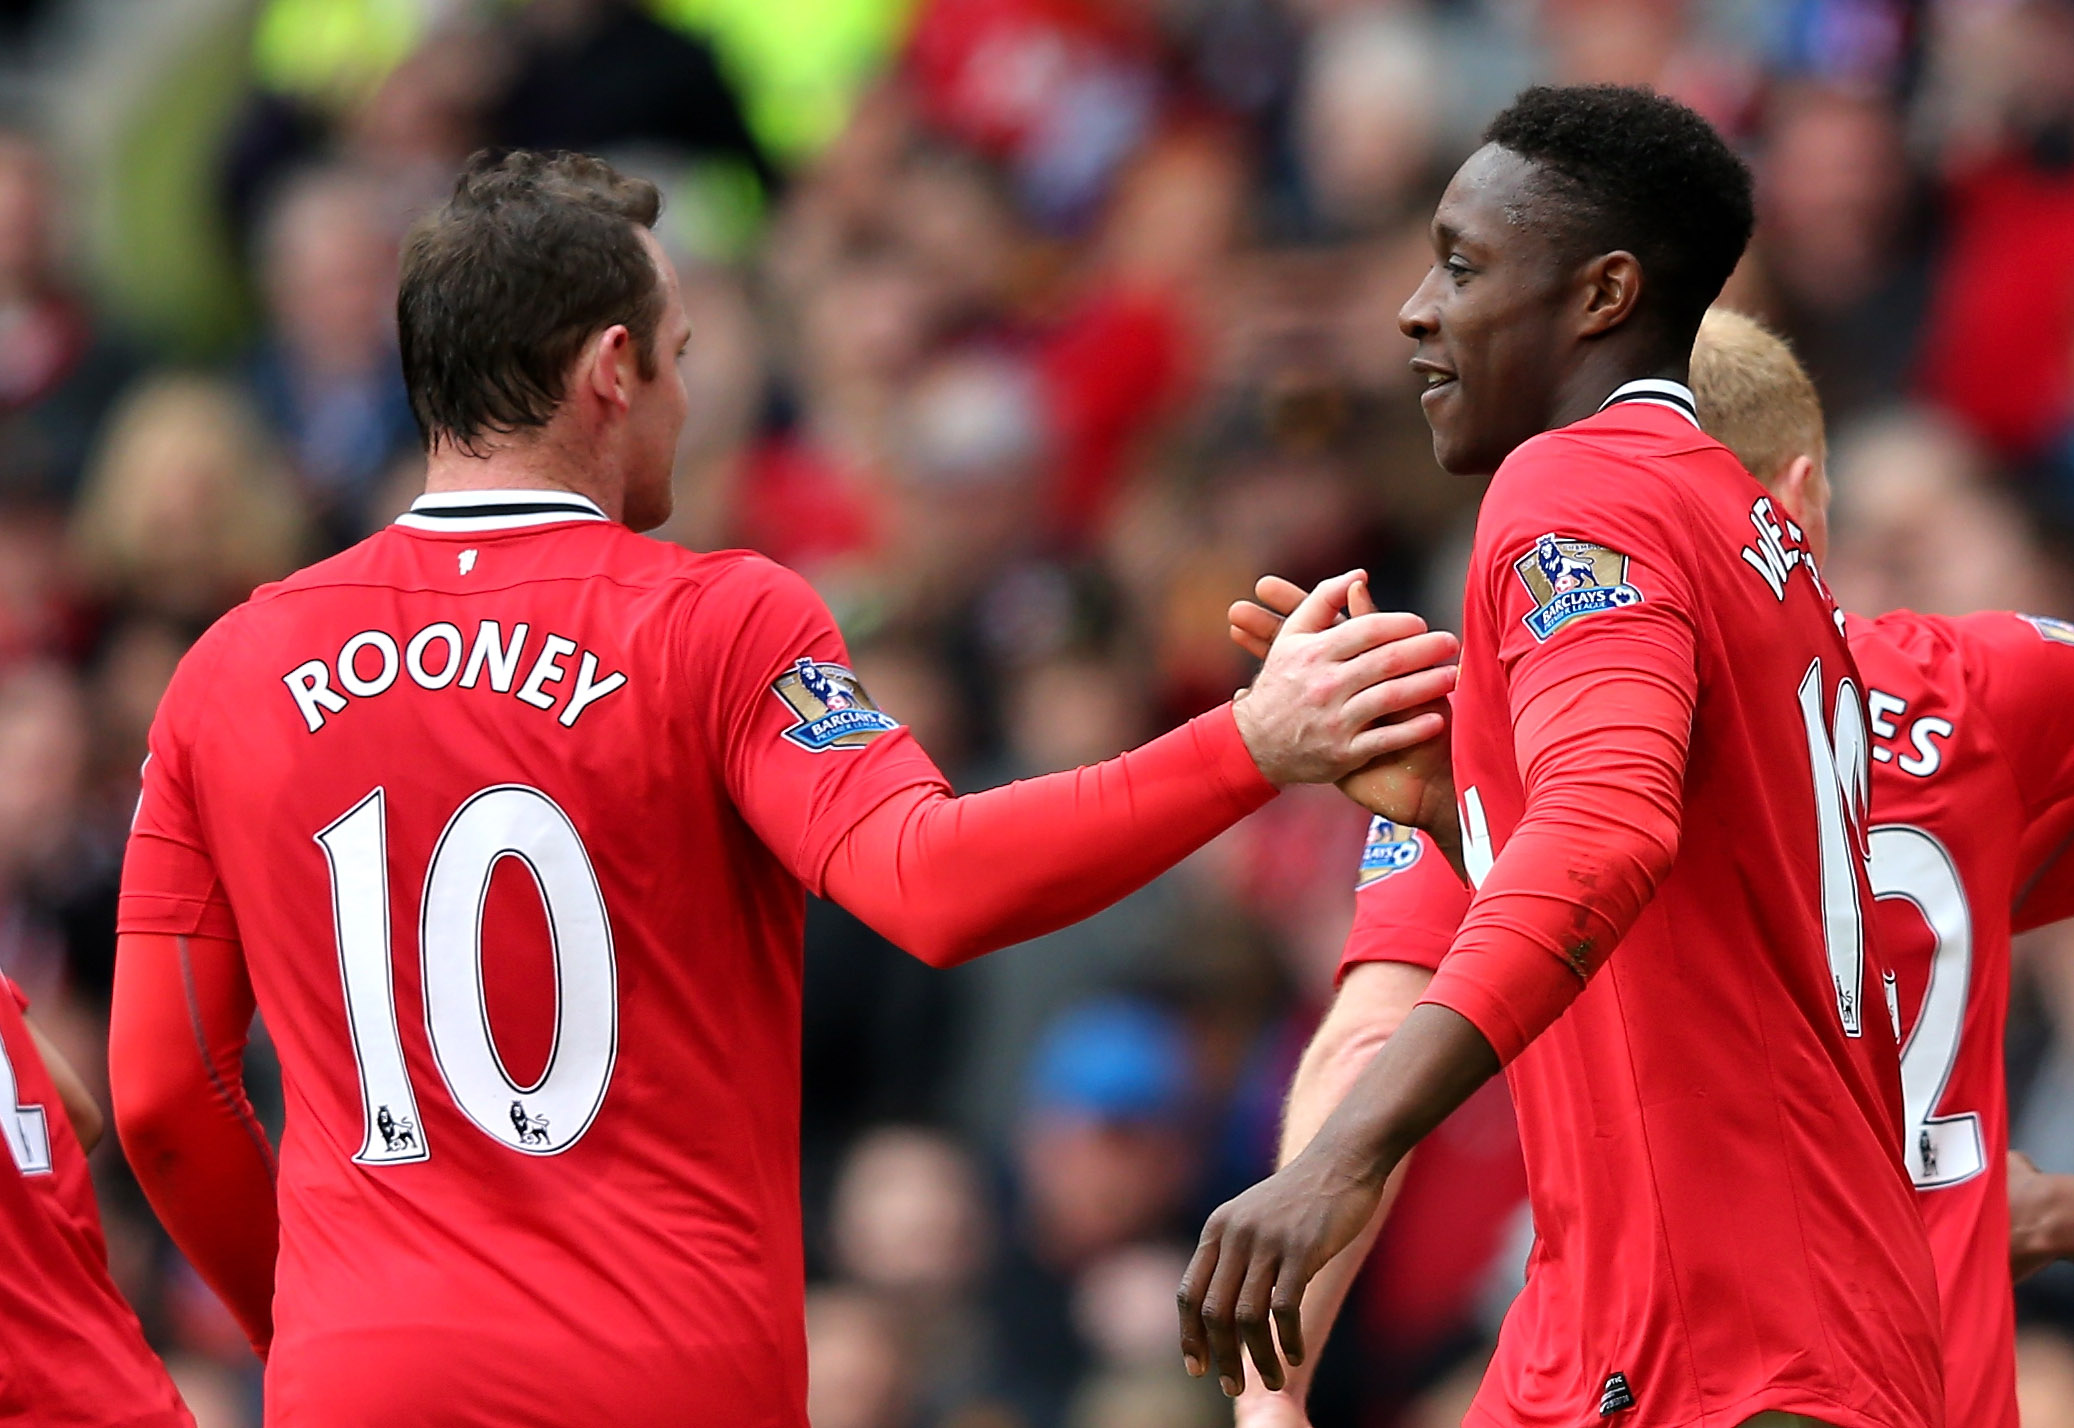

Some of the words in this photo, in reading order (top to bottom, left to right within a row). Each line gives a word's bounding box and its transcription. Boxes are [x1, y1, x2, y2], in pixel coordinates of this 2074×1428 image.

[1543, 590, 1606, 624] BARCLAYS
[282, 620, 627, 733] ROONEY
[811, 711, 877, 736] BARCLAYS
[313, 783, 618, 1165] 10
